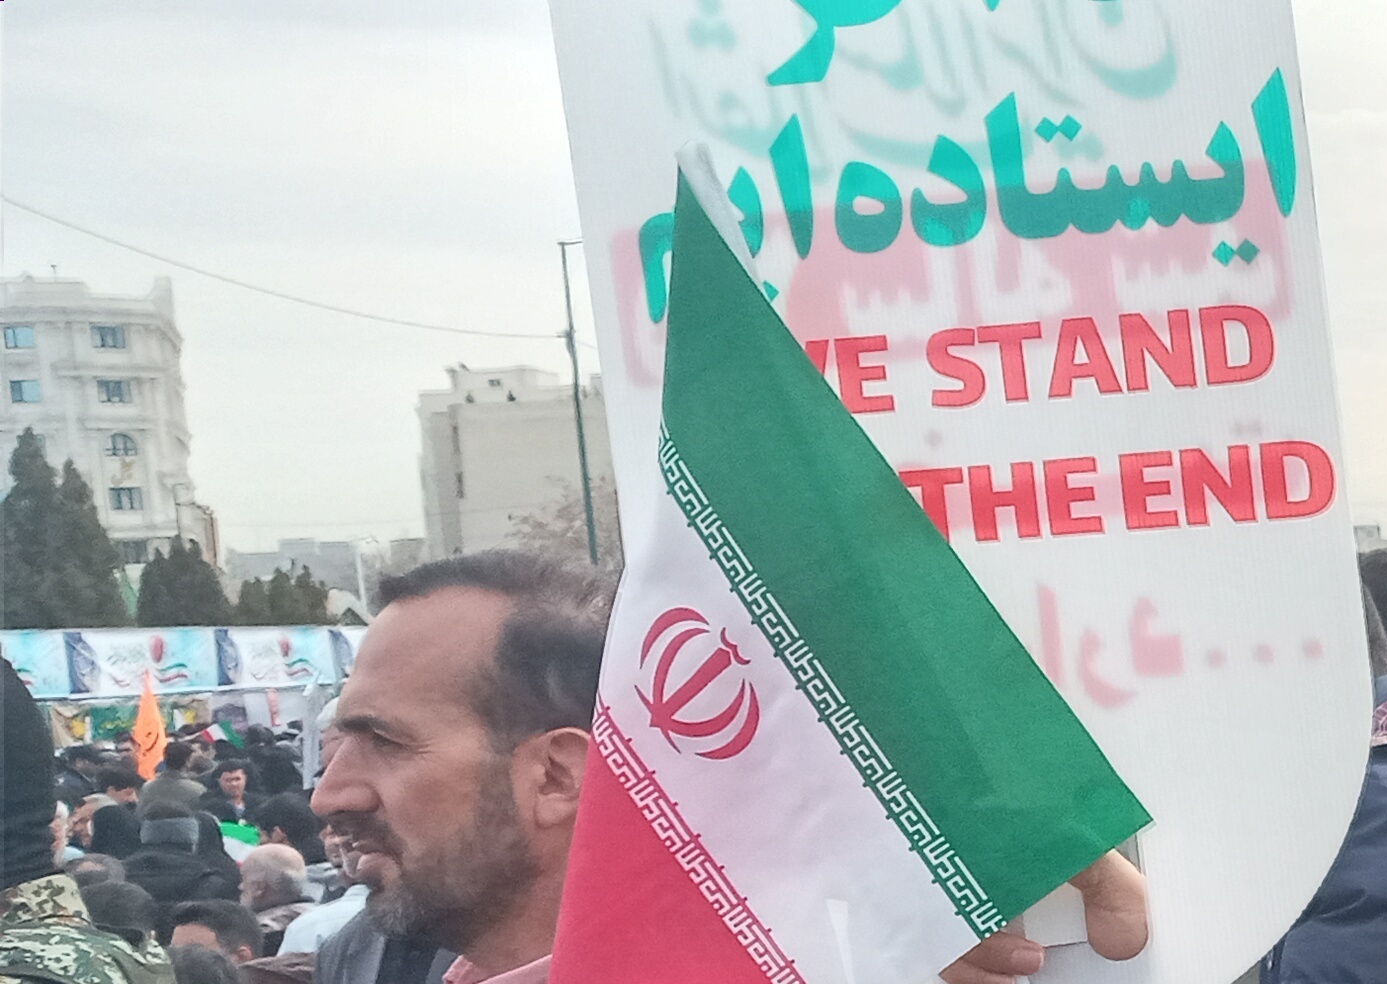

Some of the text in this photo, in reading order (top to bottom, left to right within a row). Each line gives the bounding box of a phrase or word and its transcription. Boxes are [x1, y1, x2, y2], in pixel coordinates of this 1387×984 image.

[834, 66, 1297, 267] ایستاده
[926, 304, 1276, 410] STAND
[898, 440, 1337, 545] THE END
